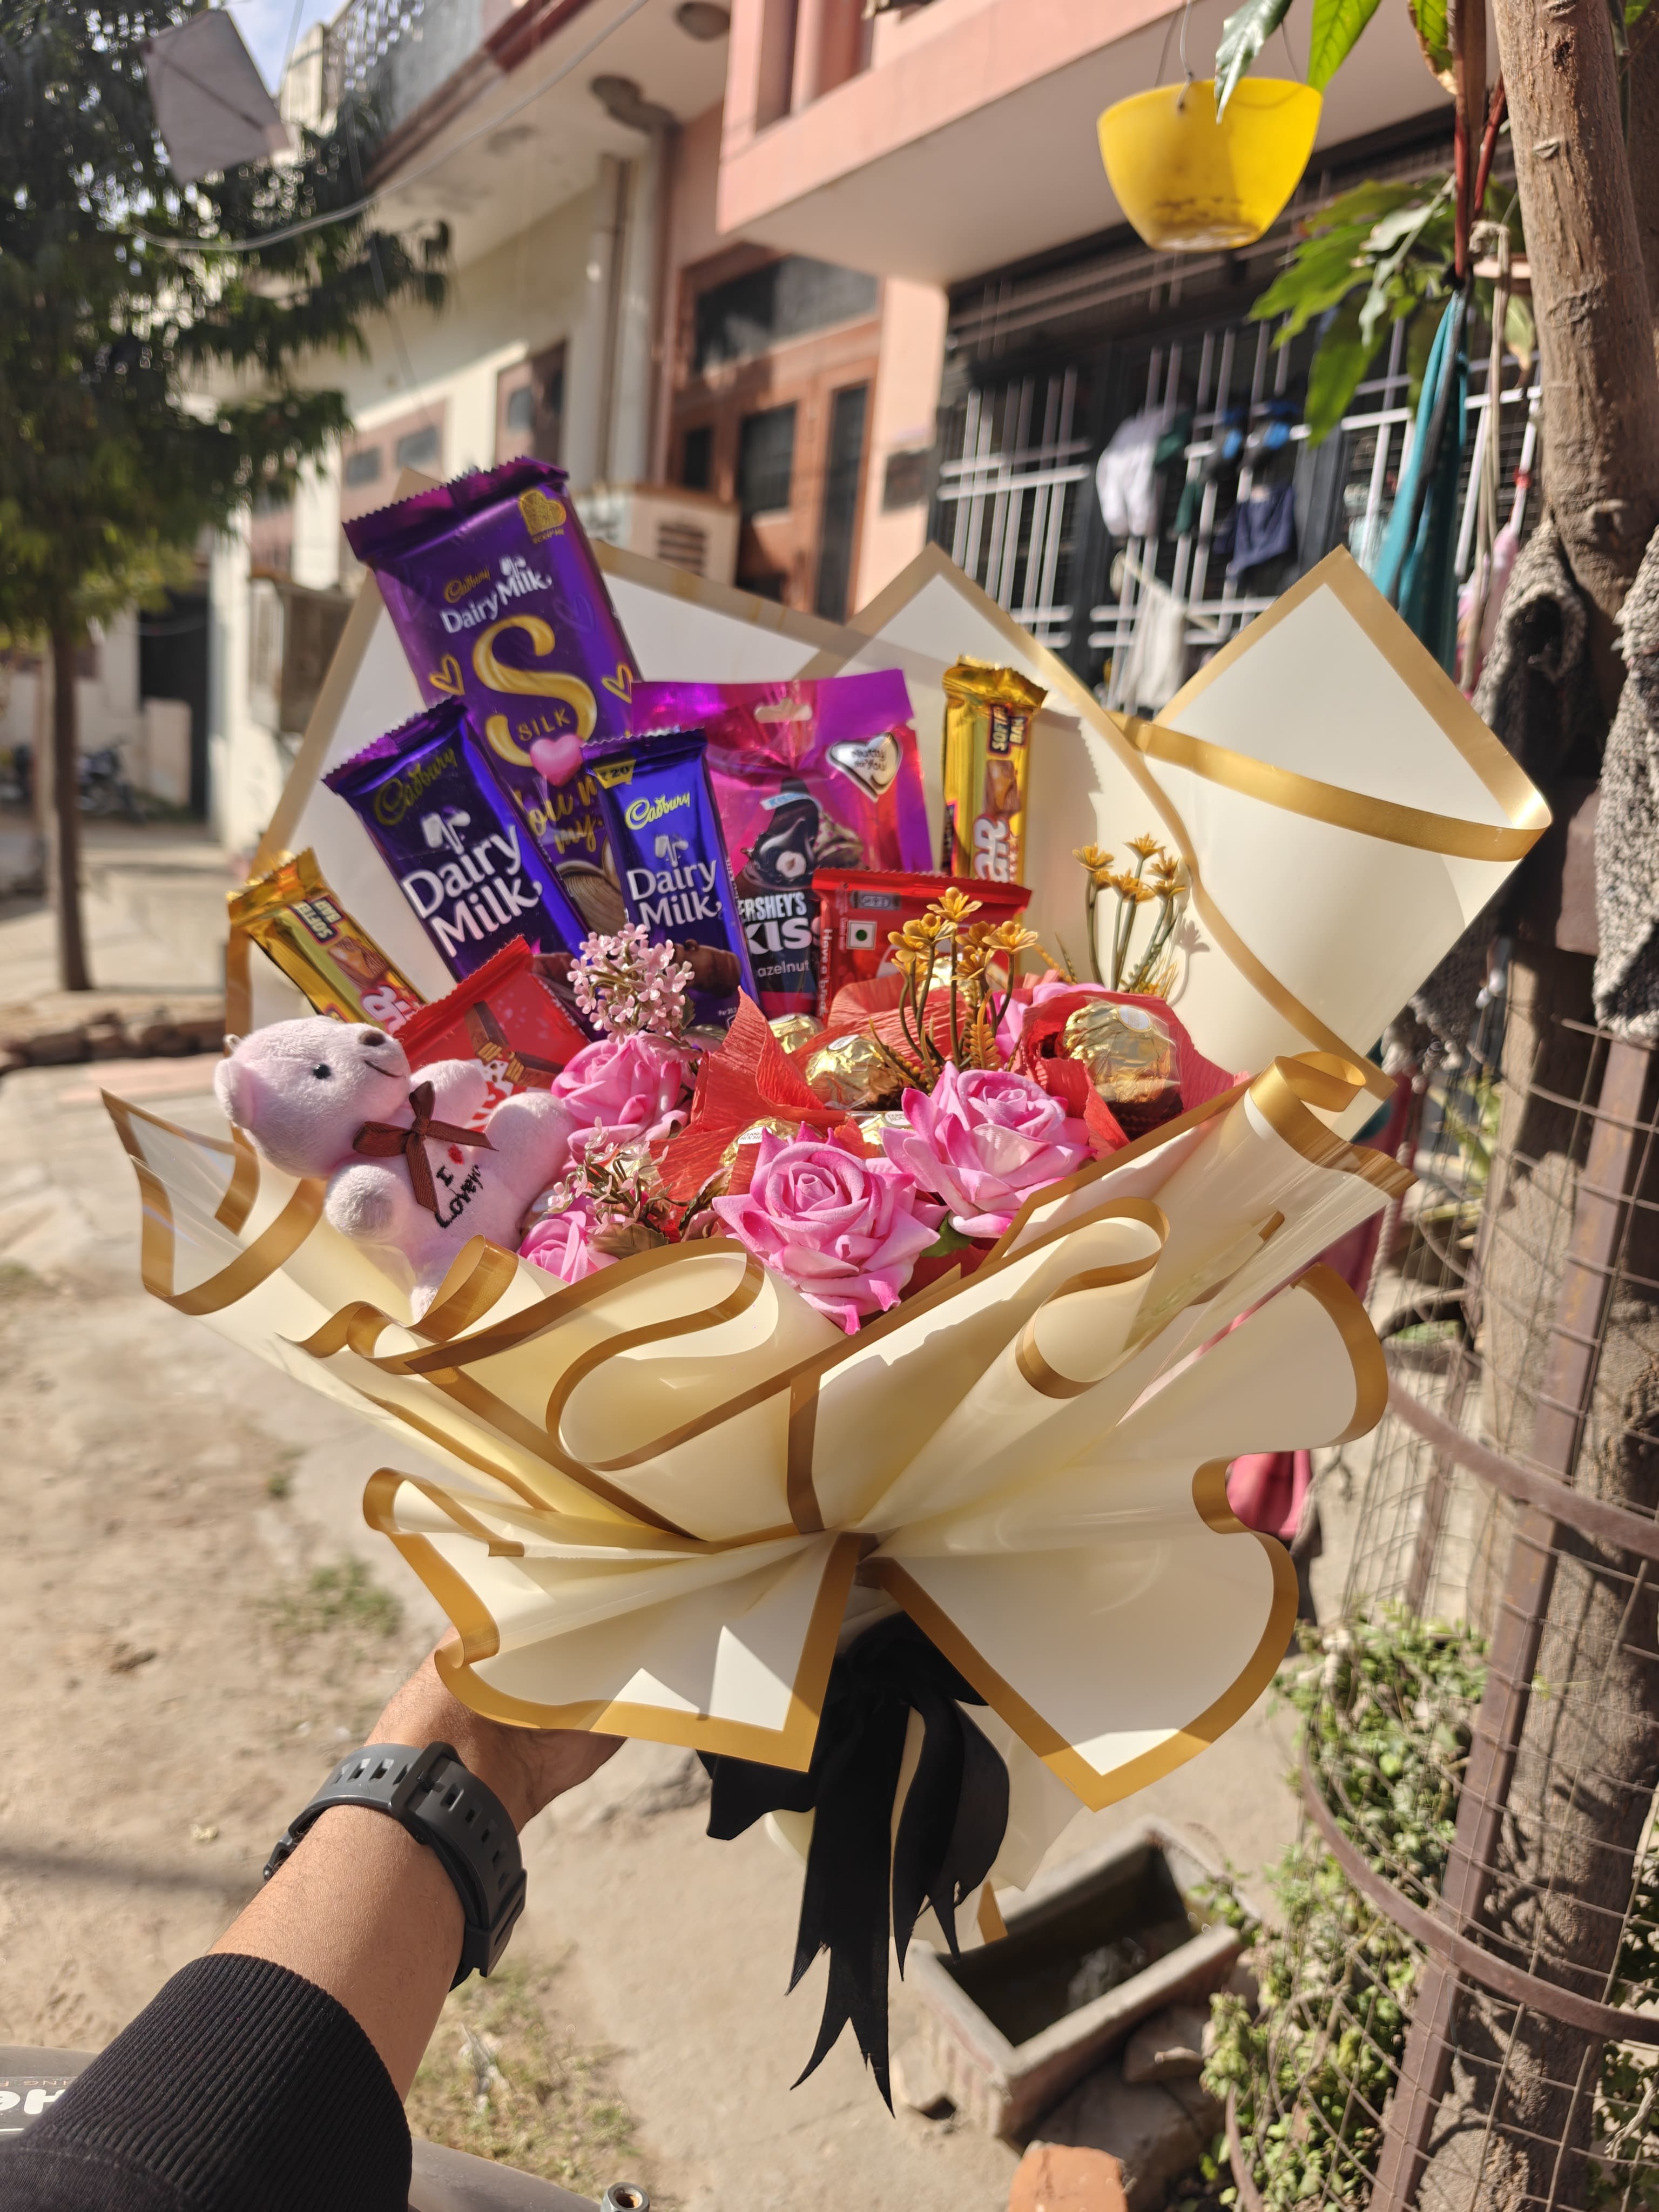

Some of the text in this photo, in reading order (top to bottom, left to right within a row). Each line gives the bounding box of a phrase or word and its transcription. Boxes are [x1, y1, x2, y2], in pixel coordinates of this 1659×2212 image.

[439, 567, 552, 634] Dairy Milk
[444, 567, 491, 604] Cadbury
[517, 707, 571, 741] SILK
[373, 747, 457, 826] Cadbury
[625, 792, 690, 831] Cadbury
[402, 826, 523, 920] Dairy
[626, 860, 718, 901] Dairy
[314, 898, 342, 924] BAR
[430, 876, 543, 959] Milk
[639, 893, 723, 933] Milk
[738, 891, 808, 922] ERSHEY'S
[820, 928, 833, 965] Have
[757, 960, 811, 977] azelnut
[820, 967, 828, 975] a
[436, 1165, 454, 1188] I
